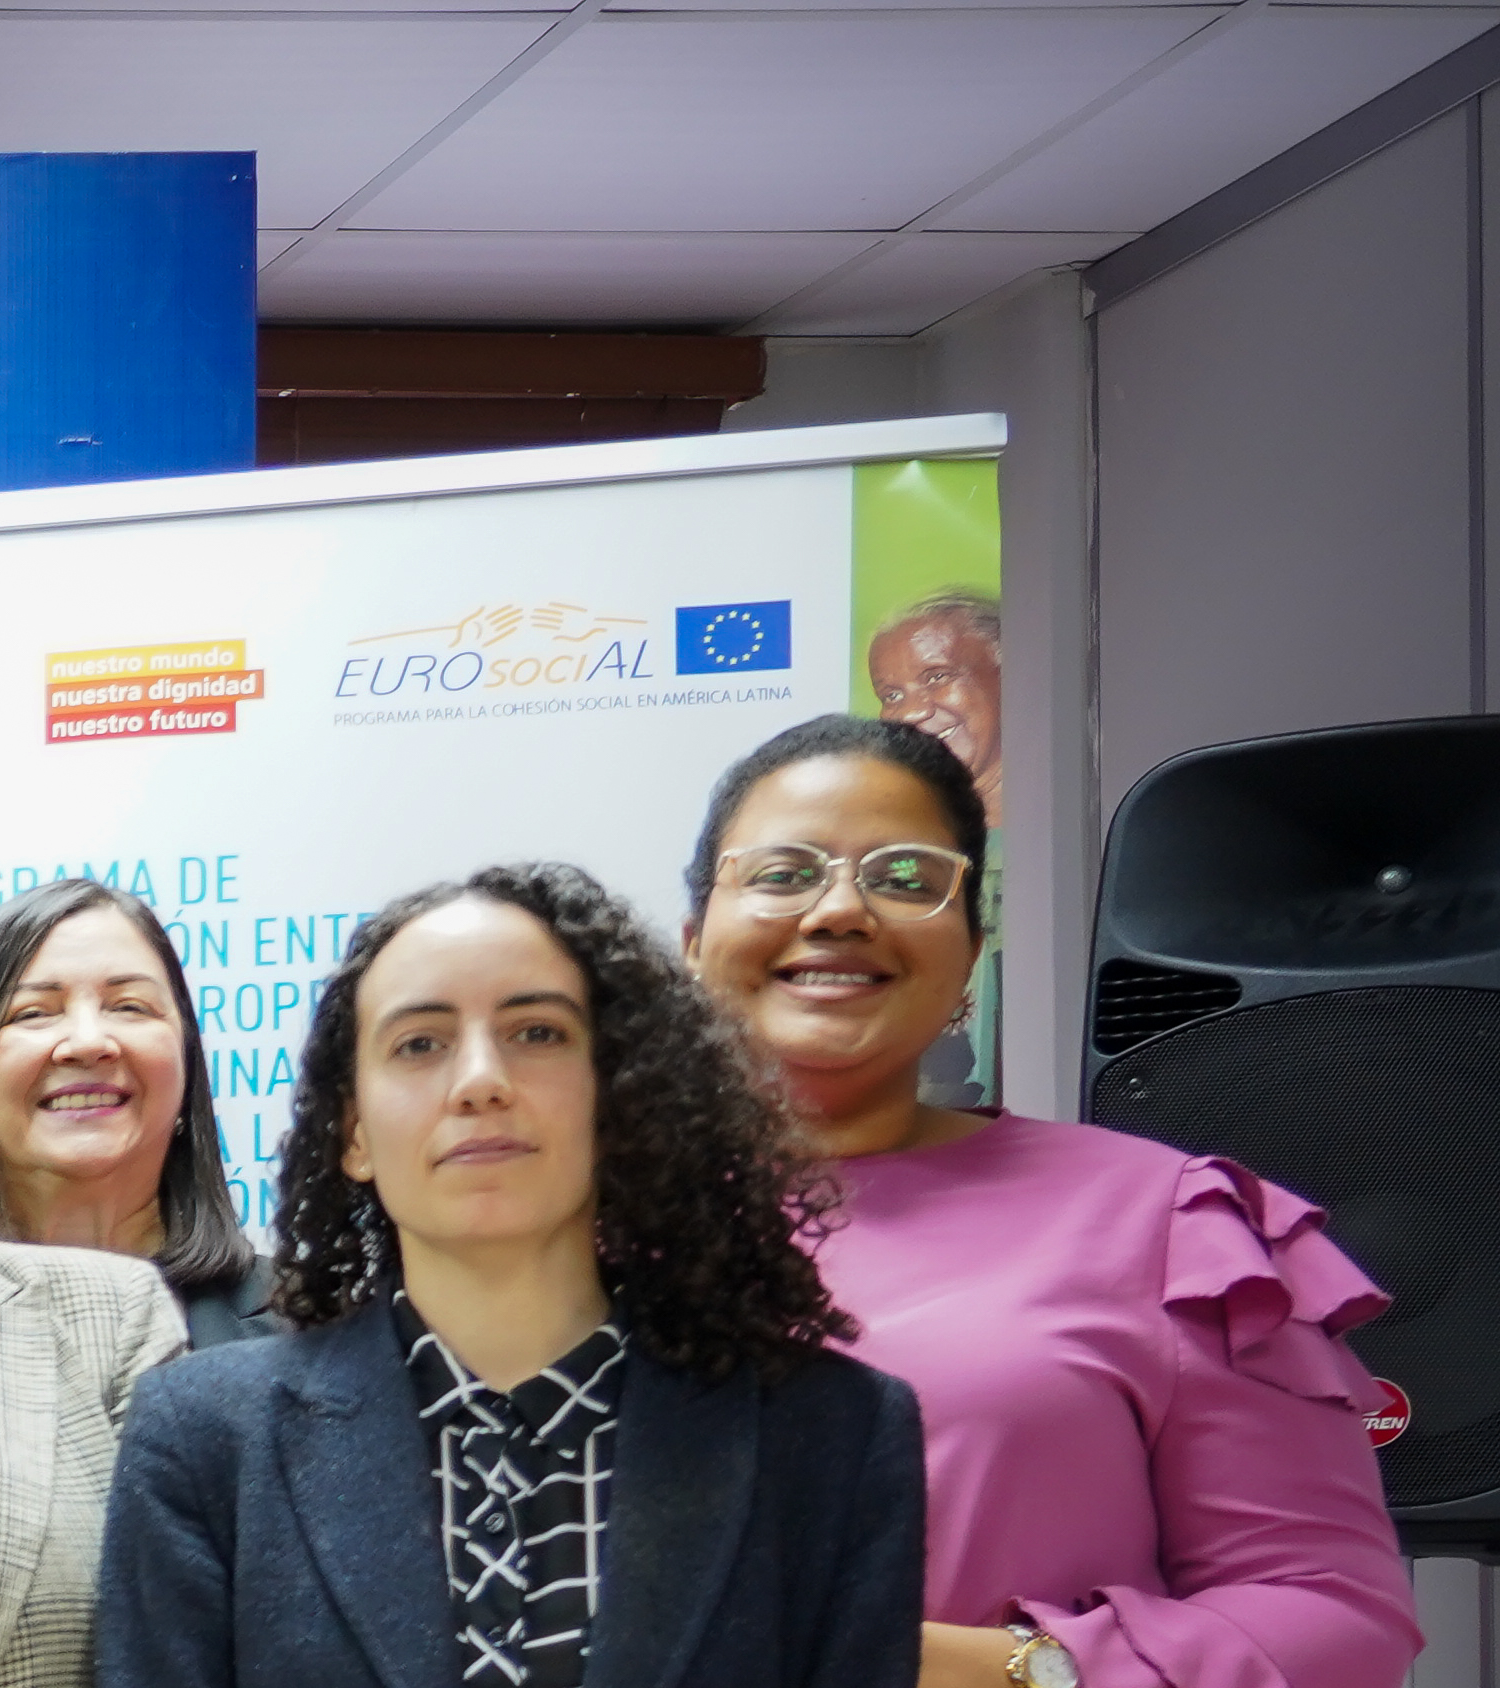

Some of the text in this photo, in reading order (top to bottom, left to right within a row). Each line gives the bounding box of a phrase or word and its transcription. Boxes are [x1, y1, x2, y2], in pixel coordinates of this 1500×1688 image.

[51, 647, 235, 679] nuestro mundo
[51, 673, 257, 708] nuestra dignidad
[333, 686, 793, 727] PROGRAMA PARA LA COHESIÓN SOCIAL EN AMÉRICA LATINA
[51, 709, 228, 738] nuestro futuro
[179, 855, 240, 905] DE
